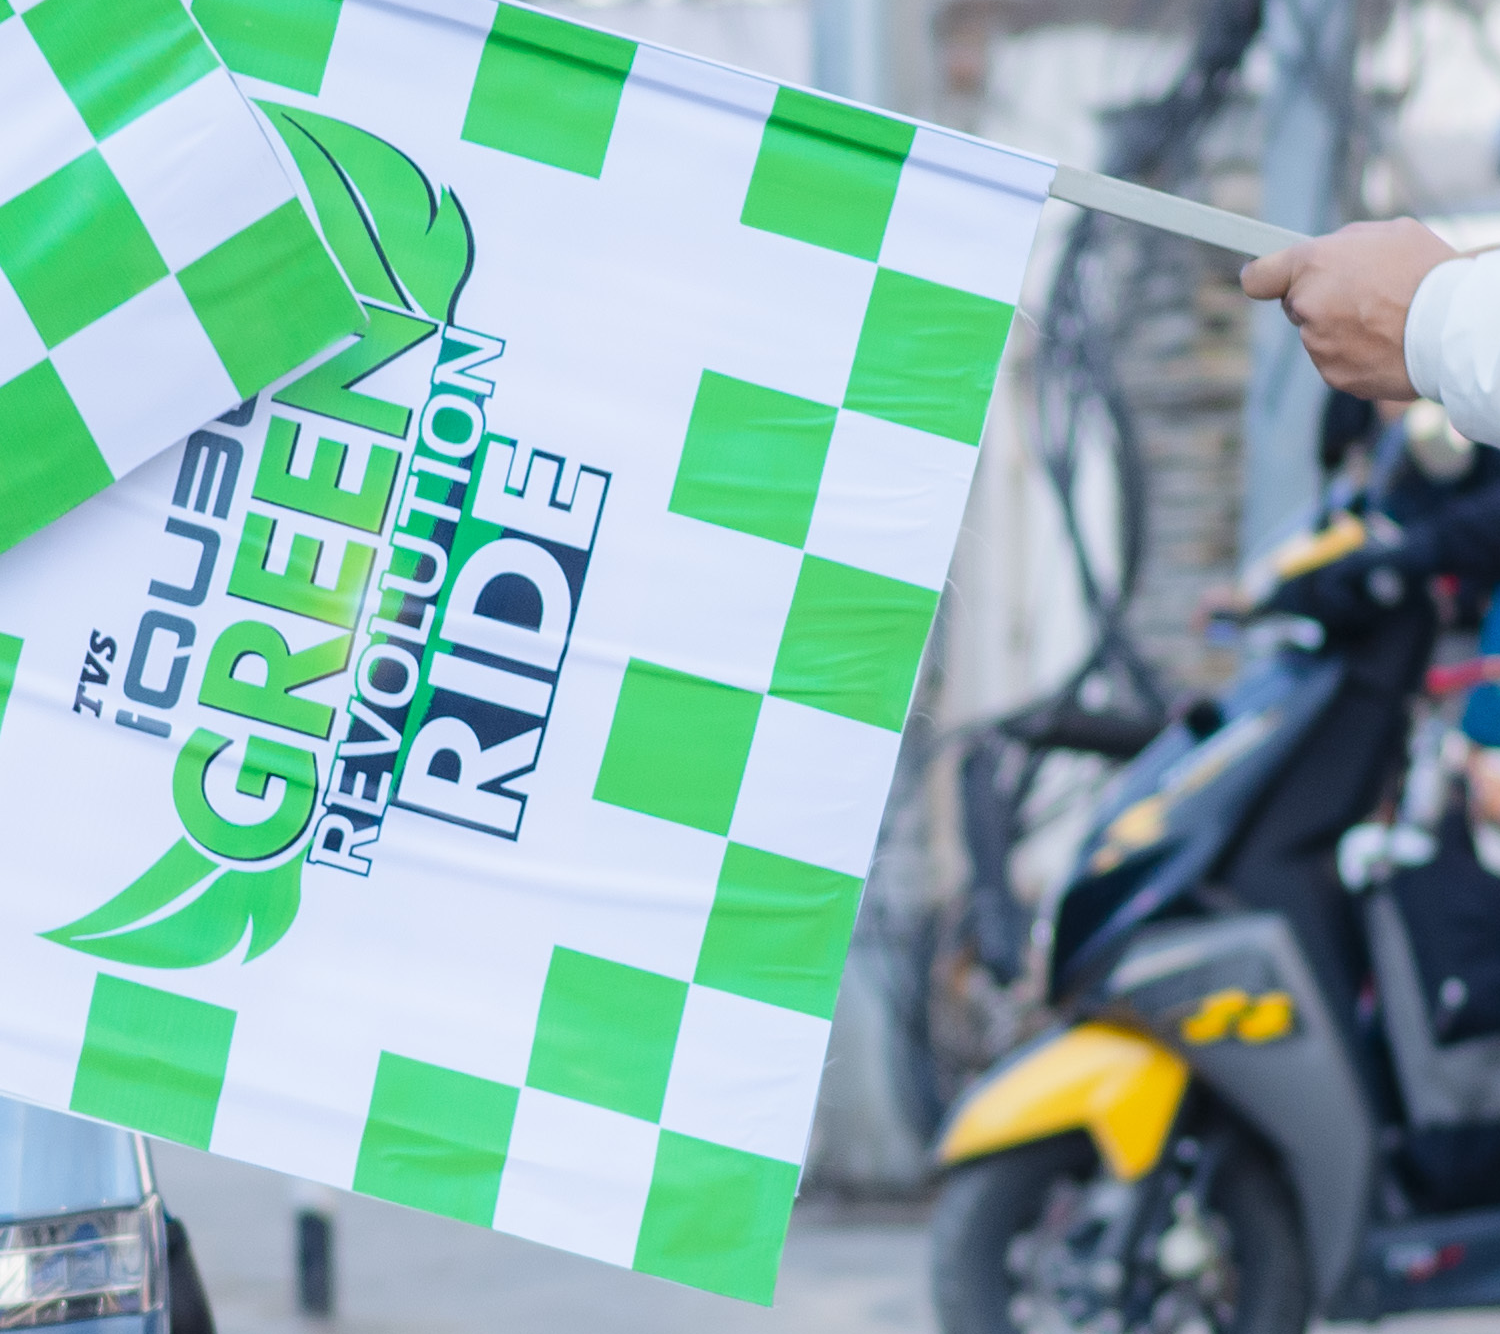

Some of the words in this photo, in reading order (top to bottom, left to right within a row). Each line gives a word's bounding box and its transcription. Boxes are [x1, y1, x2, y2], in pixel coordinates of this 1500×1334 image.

[72, 627, 119, 720] TVS
[172, 299, 440, 863] GREEN
[305, 323, 507, 878] REVOLUTION
[393, 431, 613, 842] RIDE
